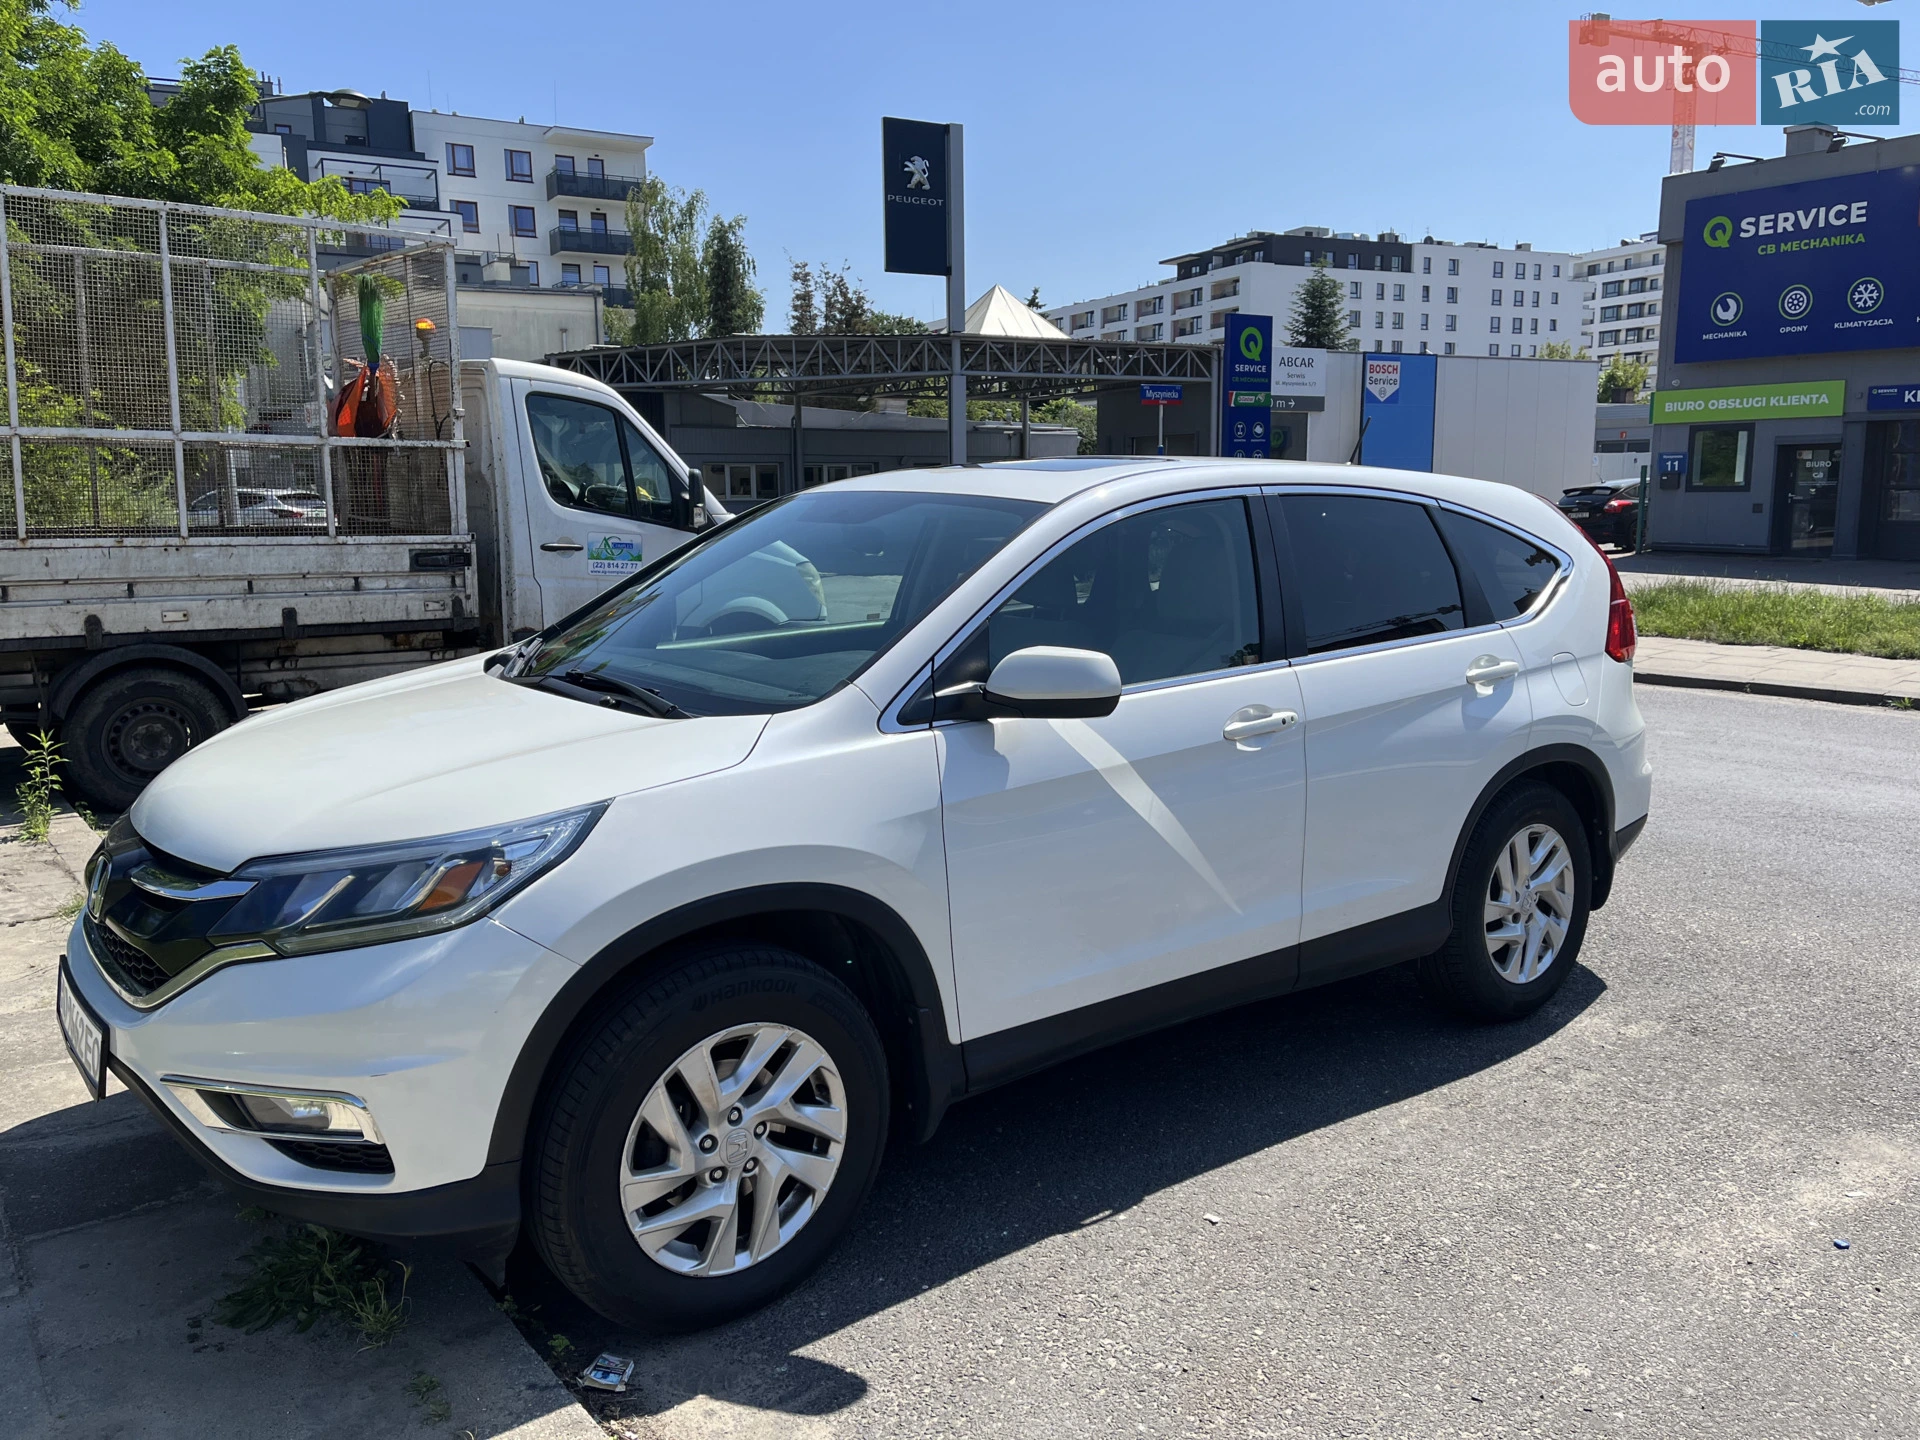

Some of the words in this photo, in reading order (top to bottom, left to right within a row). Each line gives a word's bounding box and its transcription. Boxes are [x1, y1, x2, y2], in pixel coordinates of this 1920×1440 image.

[887, 194, 945, 207] PEUGEOT
[1703, 215, 1734, 249] Q
[1739, 201, 1869, 239] SERVICE
[1757, 243, 1777, 256] CB
[1780, 232, 1866, 253] MECHANIKA
[1779, 324, 1809, 334] OPONY
[1834, 317, 1894, 330] KLIMATYZACJA
[1702, 330, 1748, 341] MECHANIKA
[1239, 326, 1264, 362] Q
[1235, 364, 1267, 373] SERVICE
[1279, 356, 1315, 369] ABCAR
[1287, 371, 1306, 380] Serwis
[1369, 363, 1399, 376] BOSCH
[1368, 375, 1399, 387] Service
[1145, 389, 1179, 400] Myszyniecka
[1664, 400, 1705, 413] BIURO
[1708, 396, 1767, 410] OBSŁUGI
[1769, 393, 1830, 407] KLIENTA
[1665, 460, 1679, 472] 11
[1805, 460, 1832, 468] BIURO
